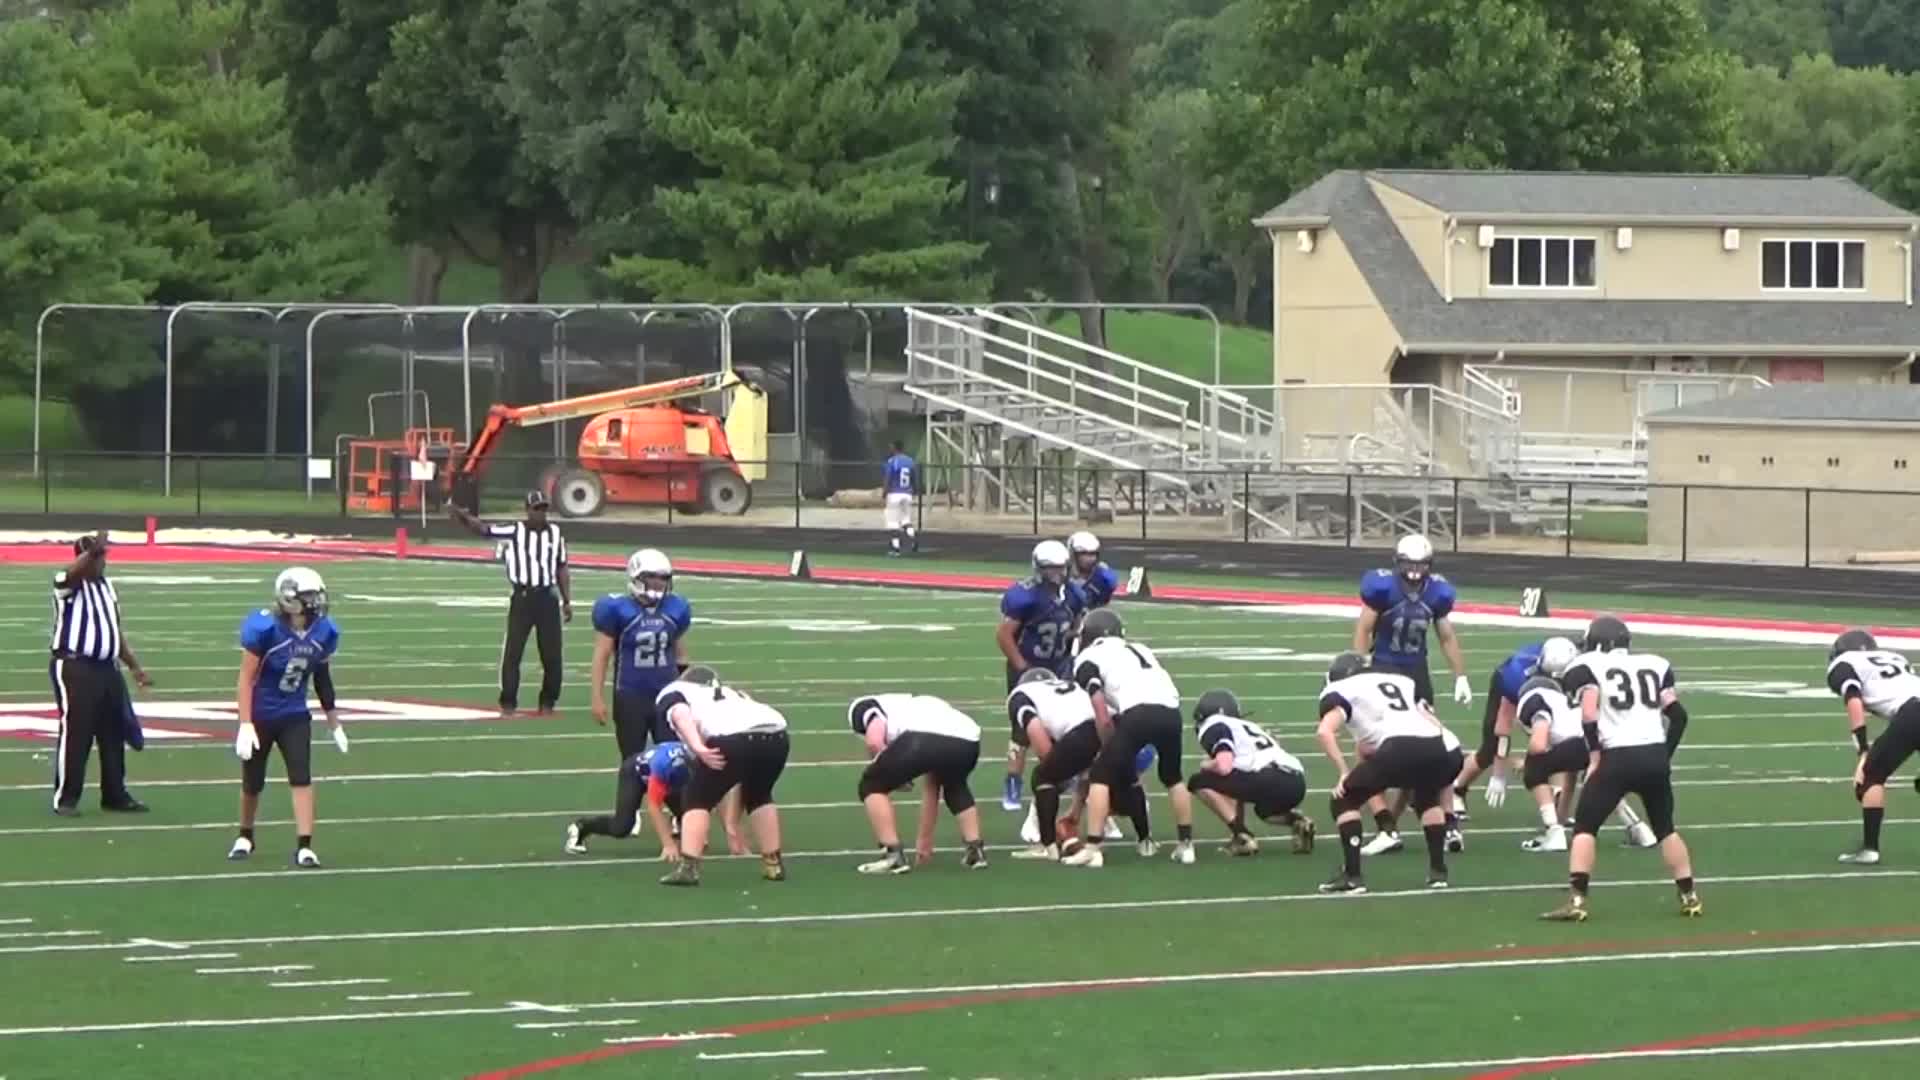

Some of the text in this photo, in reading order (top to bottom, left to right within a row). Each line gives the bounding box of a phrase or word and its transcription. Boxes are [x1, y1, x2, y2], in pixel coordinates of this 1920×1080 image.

[899, 467, 911, 487] 6
[1519, 586, 1542, 616] 30
[633, 631, 669, 668] 21
[1124, 644, 1152, 670] 1
[1377, 682, 1410, 711] 9
[1605, 667, 1661, 711] 30
